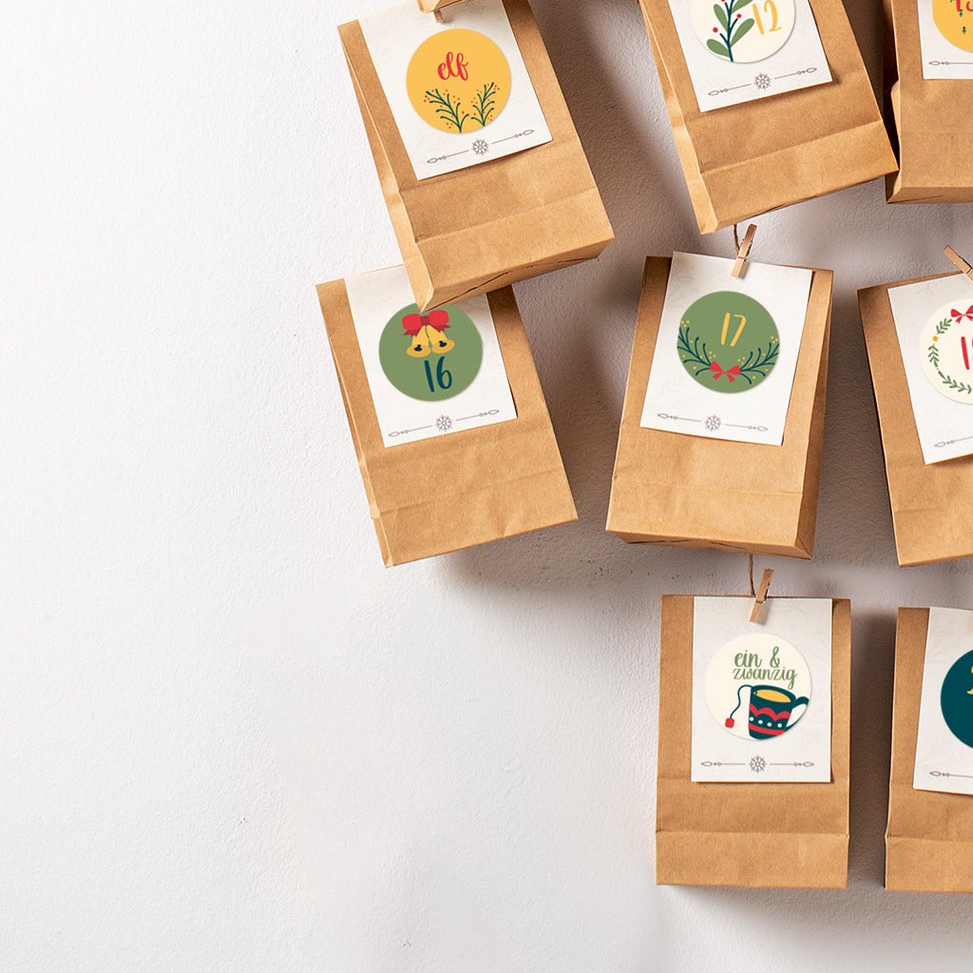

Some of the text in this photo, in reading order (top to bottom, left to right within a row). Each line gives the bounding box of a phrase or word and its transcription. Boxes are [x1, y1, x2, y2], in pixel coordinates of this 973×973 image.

[751, 0, 782, 36] 12
[437, 51, 469, 82] elf
[720, 312, 747, 347] 17
[424, 356, 453, 393] 16
[734, 646, 781, 668] ein &
[733, 666, 798, 689] zwanzig
